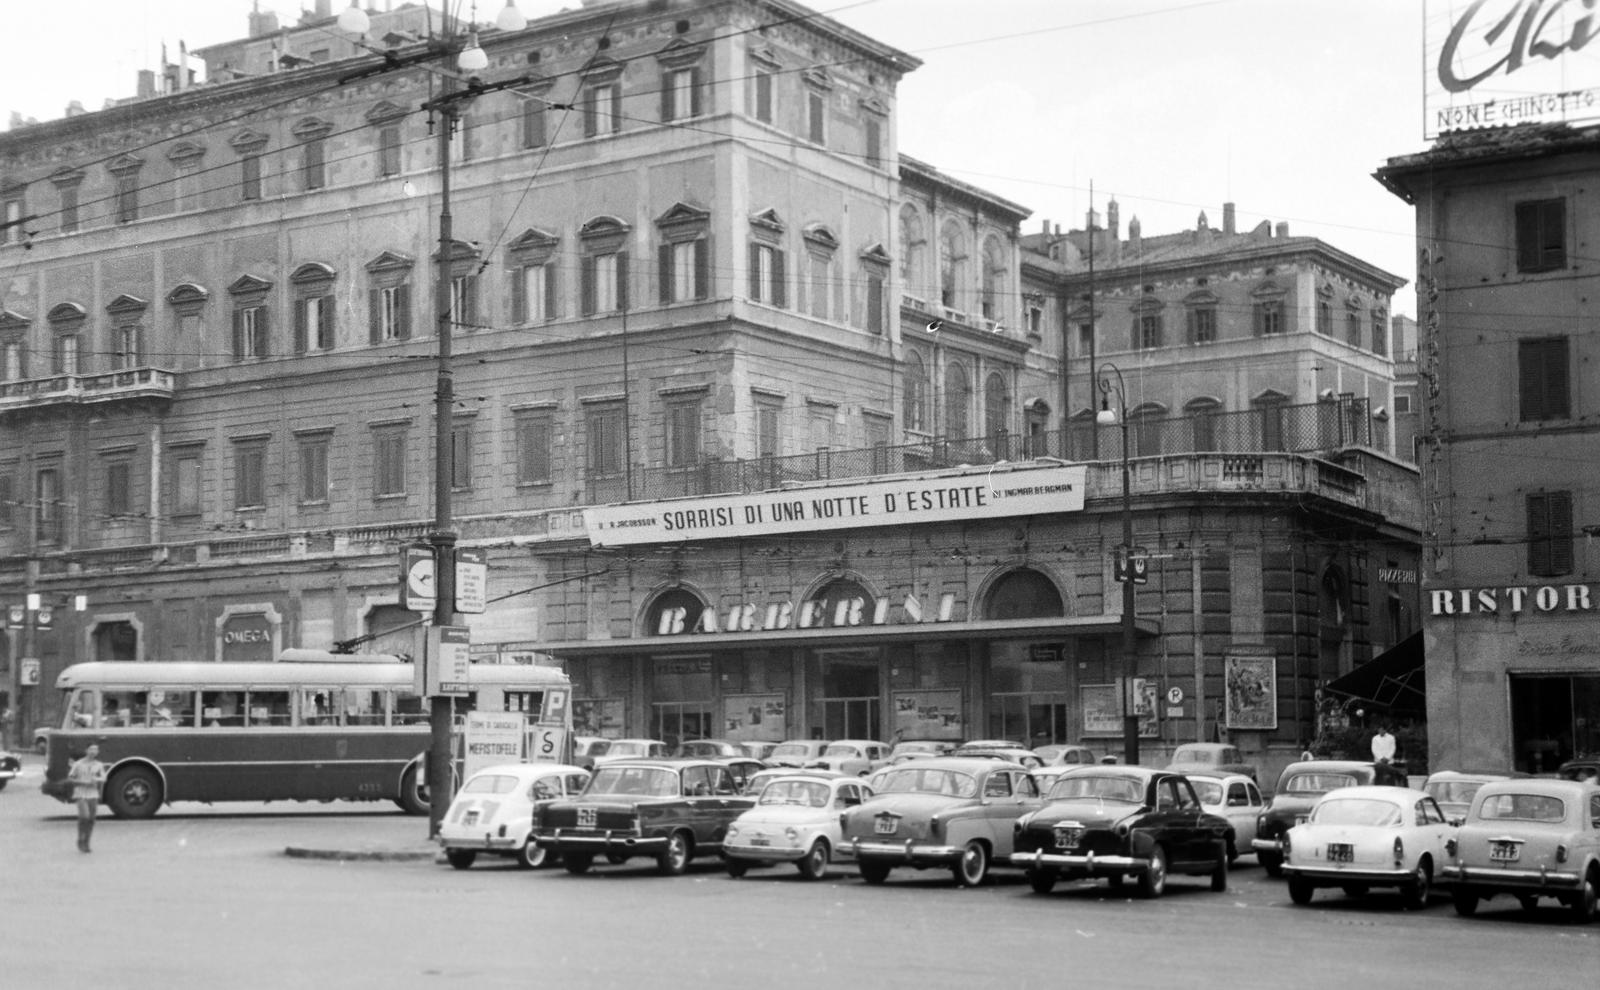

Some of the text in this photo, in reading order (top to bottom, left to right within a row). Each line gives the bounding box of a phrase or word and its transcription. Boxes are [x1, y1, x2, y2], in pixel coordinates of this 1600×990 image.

[663, 507, 734, 531] SORRISI
[744, 504, 763, 524] DI
[771, 501, 805, 522] UNA
[812, 495, 870, 519] NOTTE
[1004, 487, 1033, 498] INGMAR
[1034, 483, 1072, 495] BERGMAN
[658, 593, 955, 635] BARBERINI
[1430, 584, 1594, 615] RISTOR
[224, 629, 270, 644] OMEGA
[547, 691, 565, 716] P
